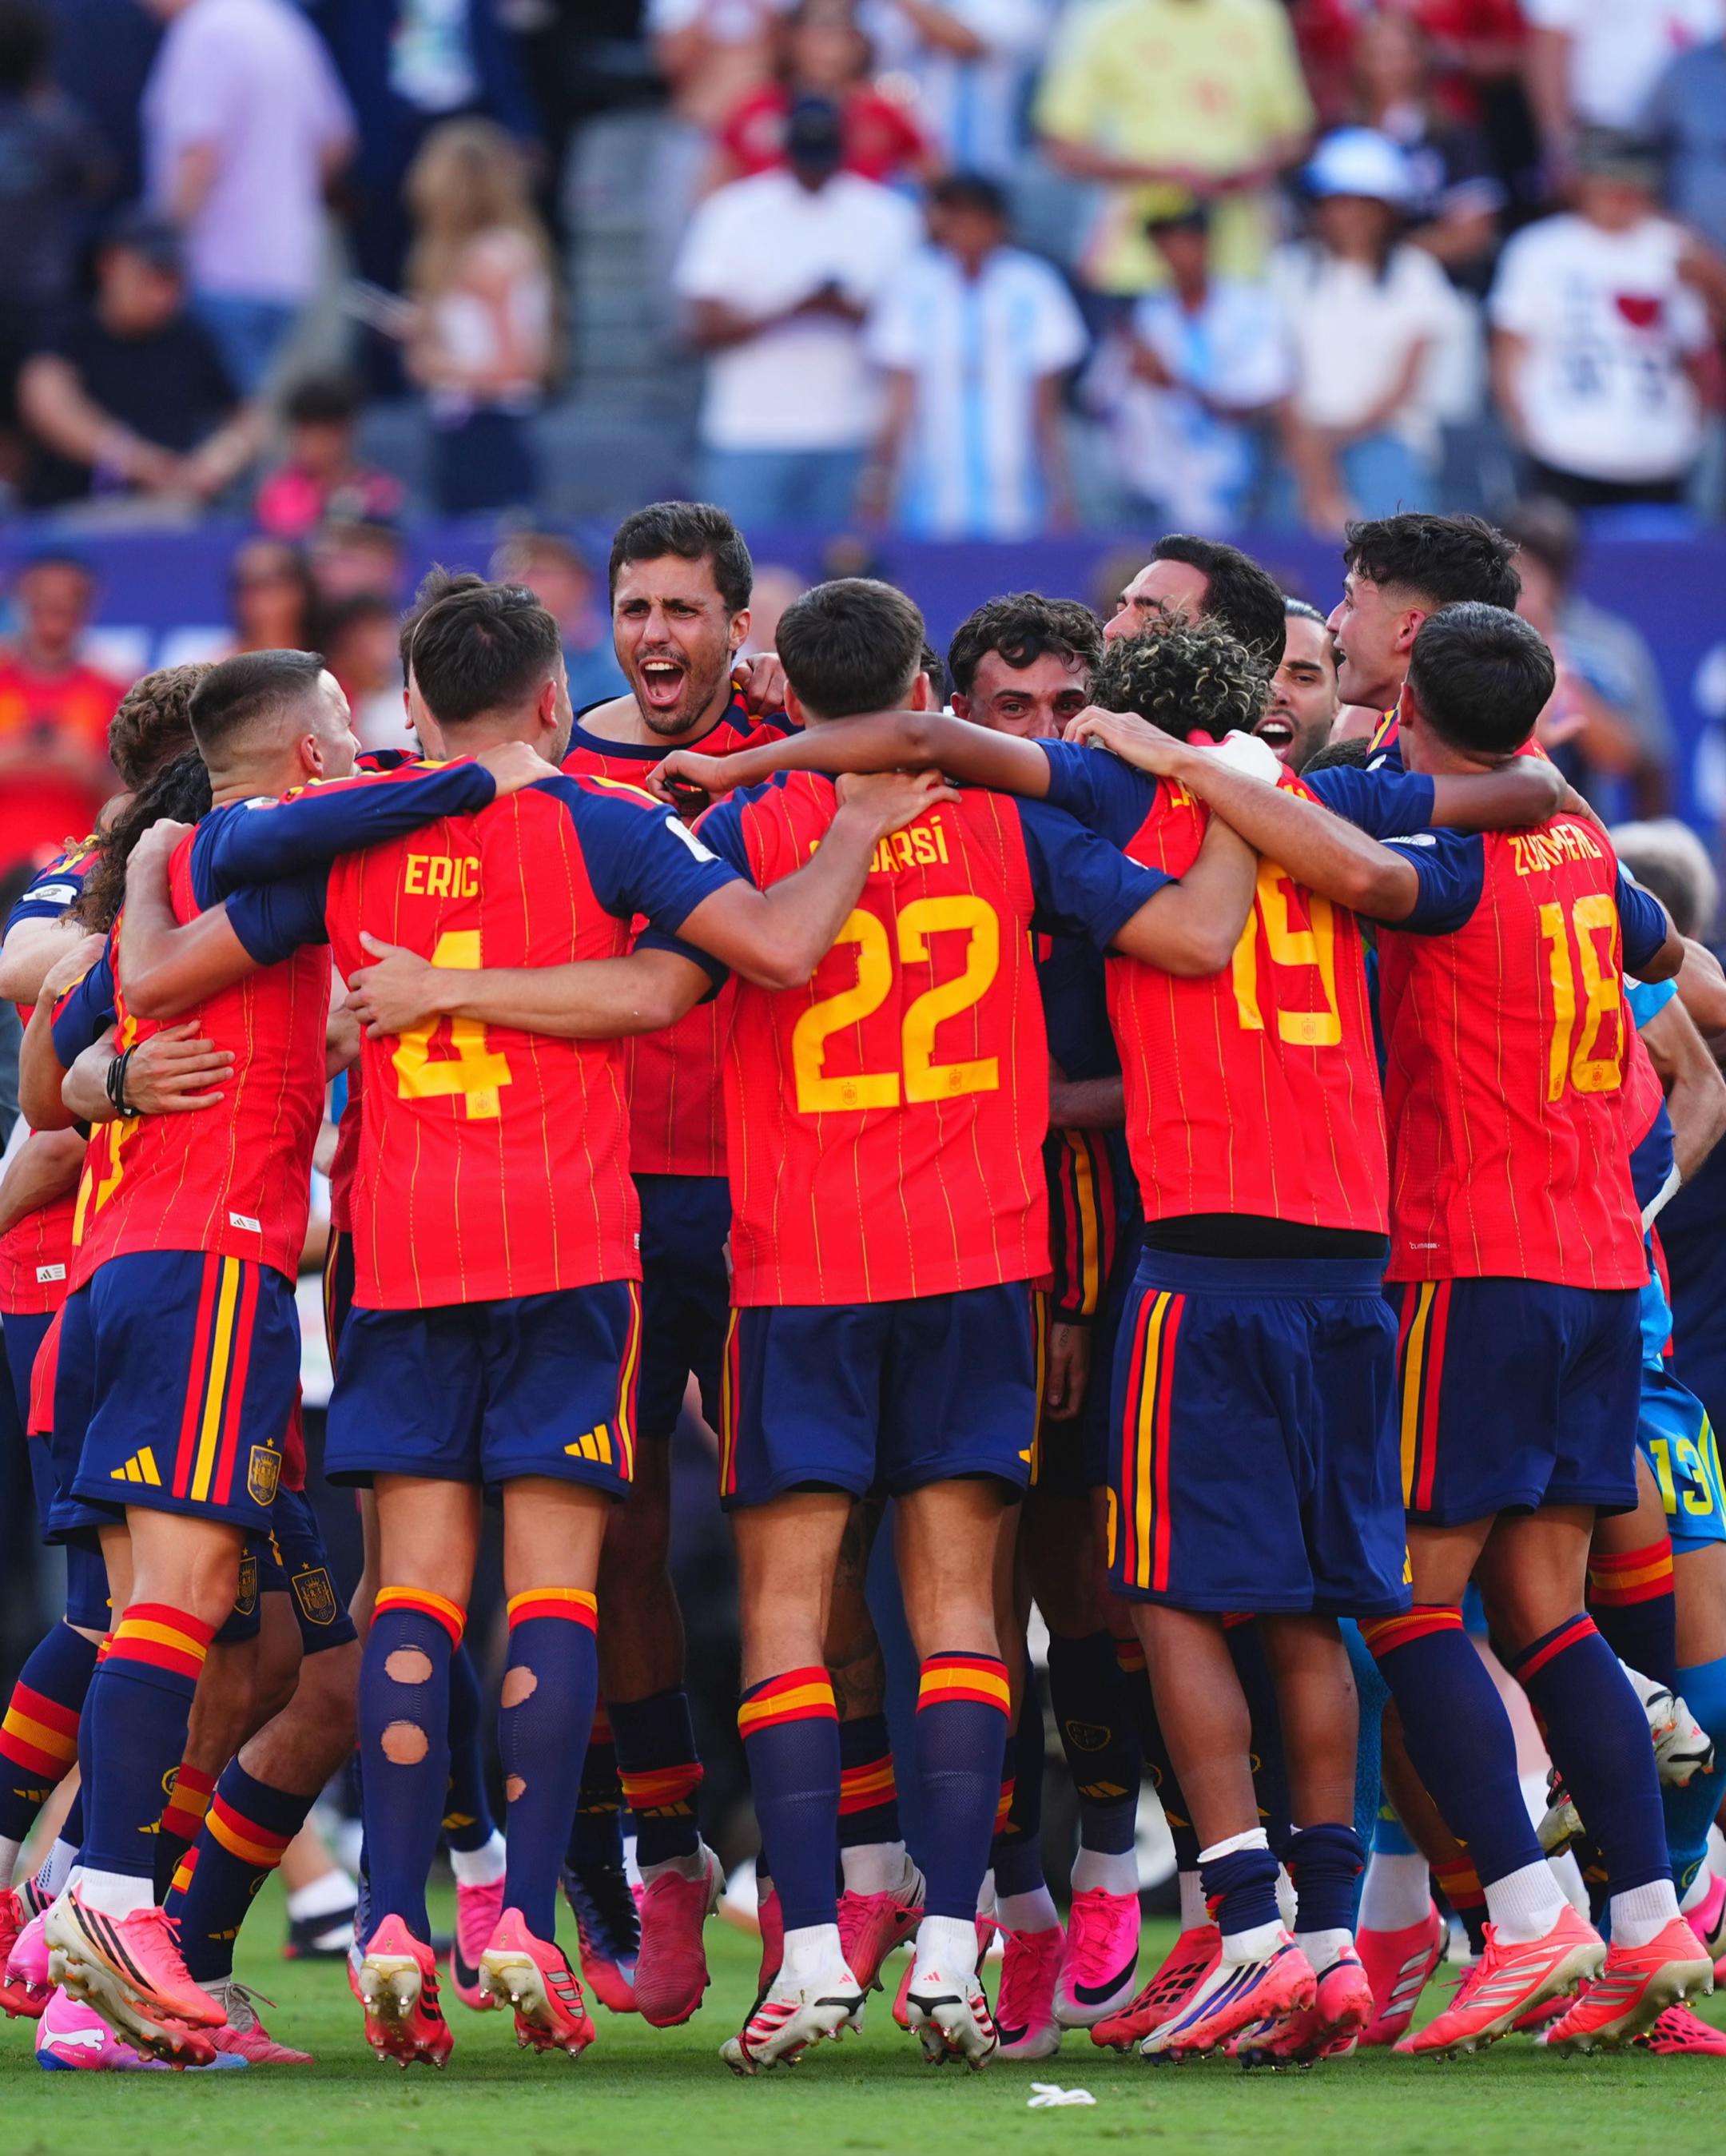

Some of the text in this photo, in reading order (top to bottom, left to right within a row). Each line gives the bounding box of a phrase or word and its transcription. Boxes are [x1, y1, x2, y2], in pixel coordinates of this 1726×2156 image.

[404, 853, 479, 898] ERIC
[1231, 858, 1342, 1046] 19
[392, 929, 512, 1120] 4
[792, 894, 1000, 1112] 22
[1538, 893, 1624, 1103] 18
[1648, 1438, 1714, 1515] 13
